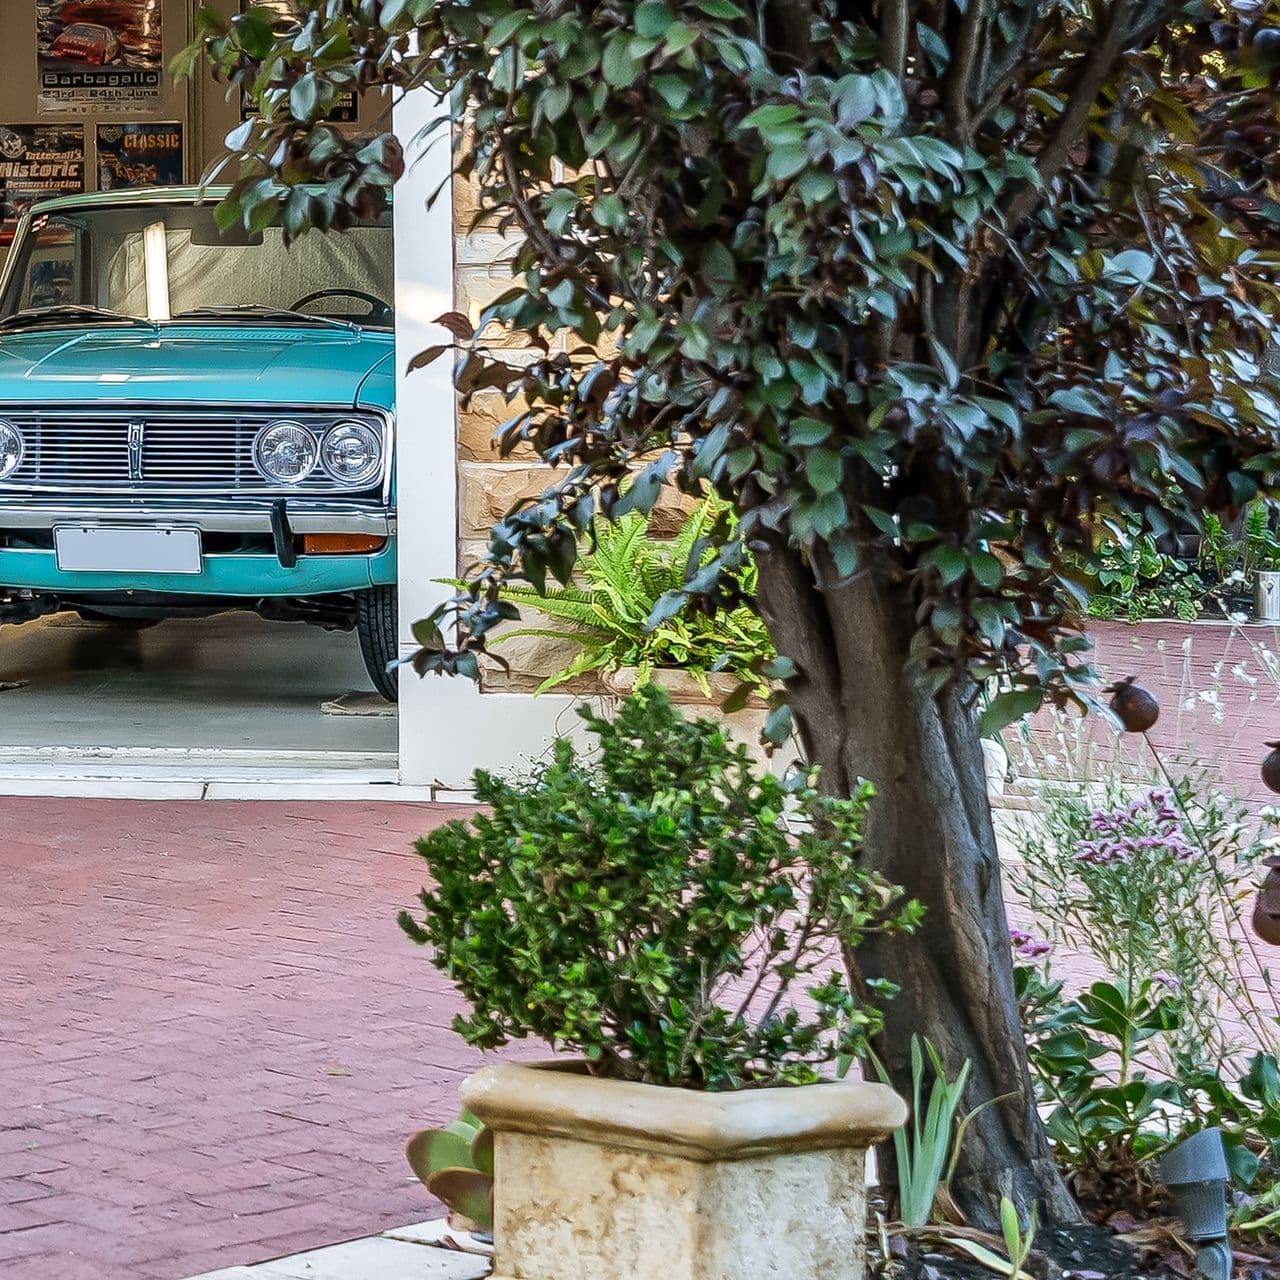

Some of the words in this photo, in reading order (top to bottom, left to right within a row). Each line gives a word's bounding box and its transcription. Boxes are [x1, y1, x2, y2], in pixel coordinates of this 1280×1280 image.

[44, 73, 157, 86] Barbagallo
[127, 88, 158, 97] June
[124, 134, 179, 149] CLASSIC
[6, 178, 81, 189] Demonstration
